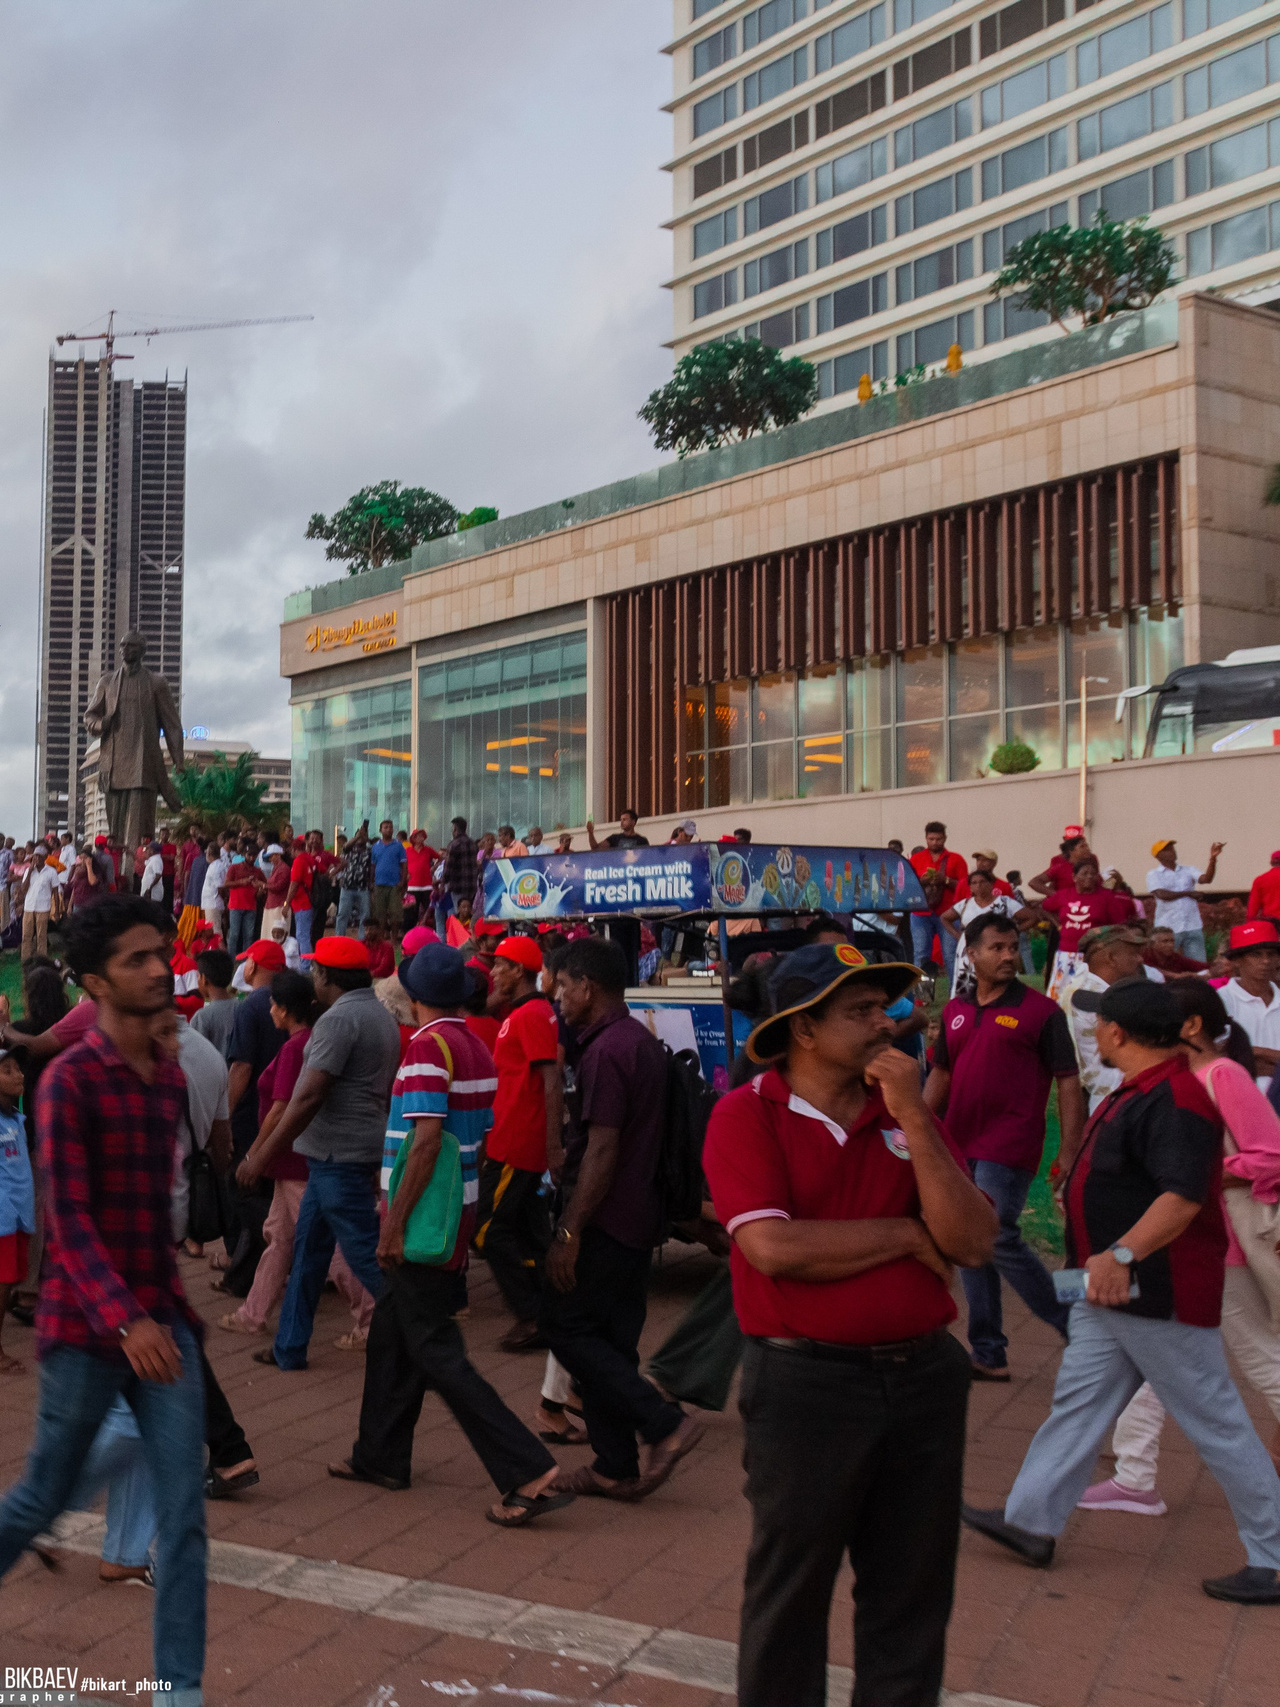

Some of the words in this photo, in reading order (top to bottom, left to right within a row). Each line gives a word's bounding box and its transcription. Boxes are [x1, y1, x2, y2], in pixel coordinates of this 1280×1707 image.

[585, 868, 607, 880] Real
[608, 867, 624, 879] Ice
[626, 865, 663, 878] Cream
[664, 861, 691, 875] with
[585, 879, 640, 904] Fresh
[646, 876, 693, 900] Milk
